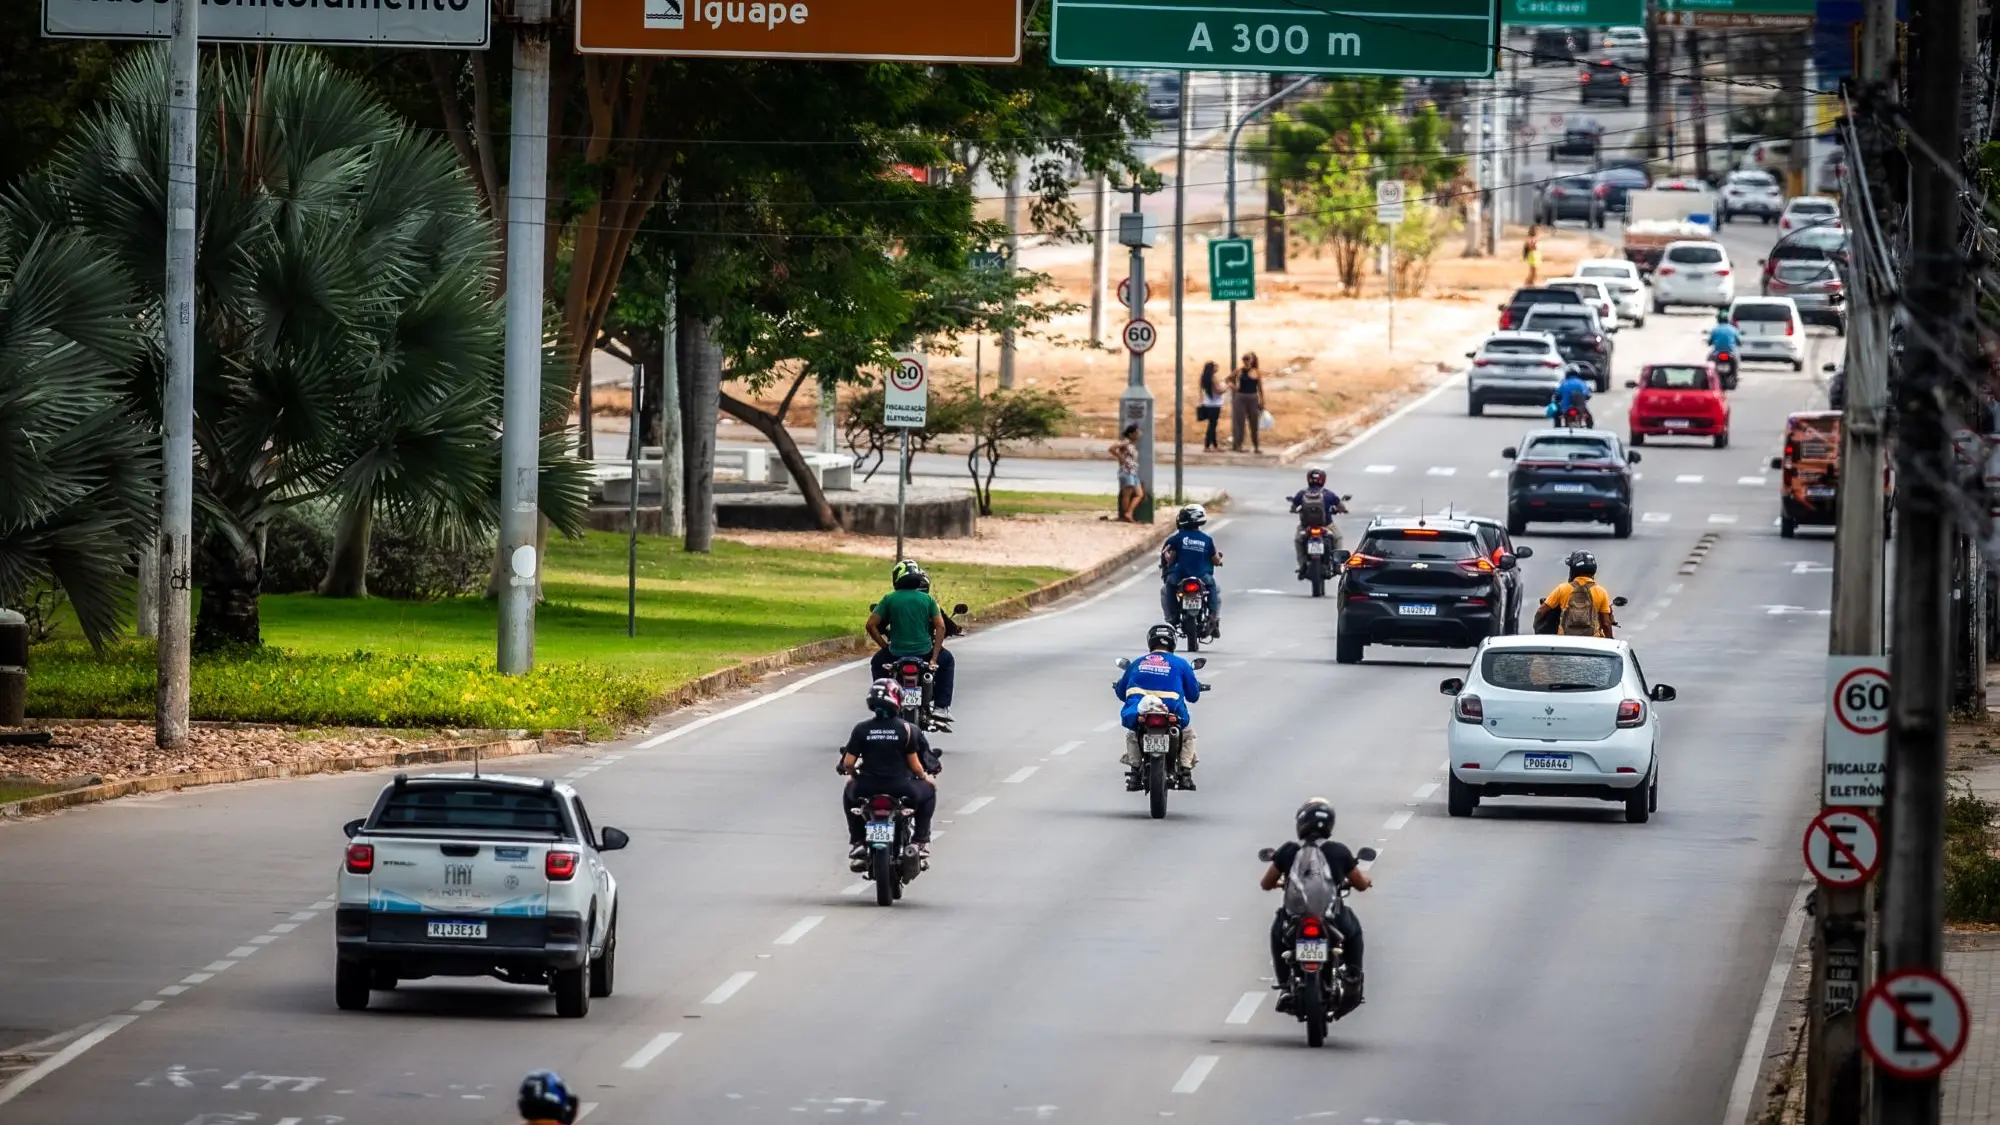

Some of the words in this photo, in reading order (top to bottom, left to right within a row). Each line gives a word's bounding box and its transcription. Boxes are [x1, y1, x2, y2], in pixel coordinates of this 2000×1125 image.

[693, 0, 809, 31] Iguape
[1187, 21, 1214, 52] A
[1231, 23, 1309, 54] 300
[1328, 32, 1361, 56] m
[1128, 327, 1151, 341] 60
[896, 366, 918, 379] 60
[1846, 683, 1890, 712] 60
[1827, 824, 1858, 870] E
[444, 863, 475, 885] FIAT
[1894, 992, 1934, 1052] E
